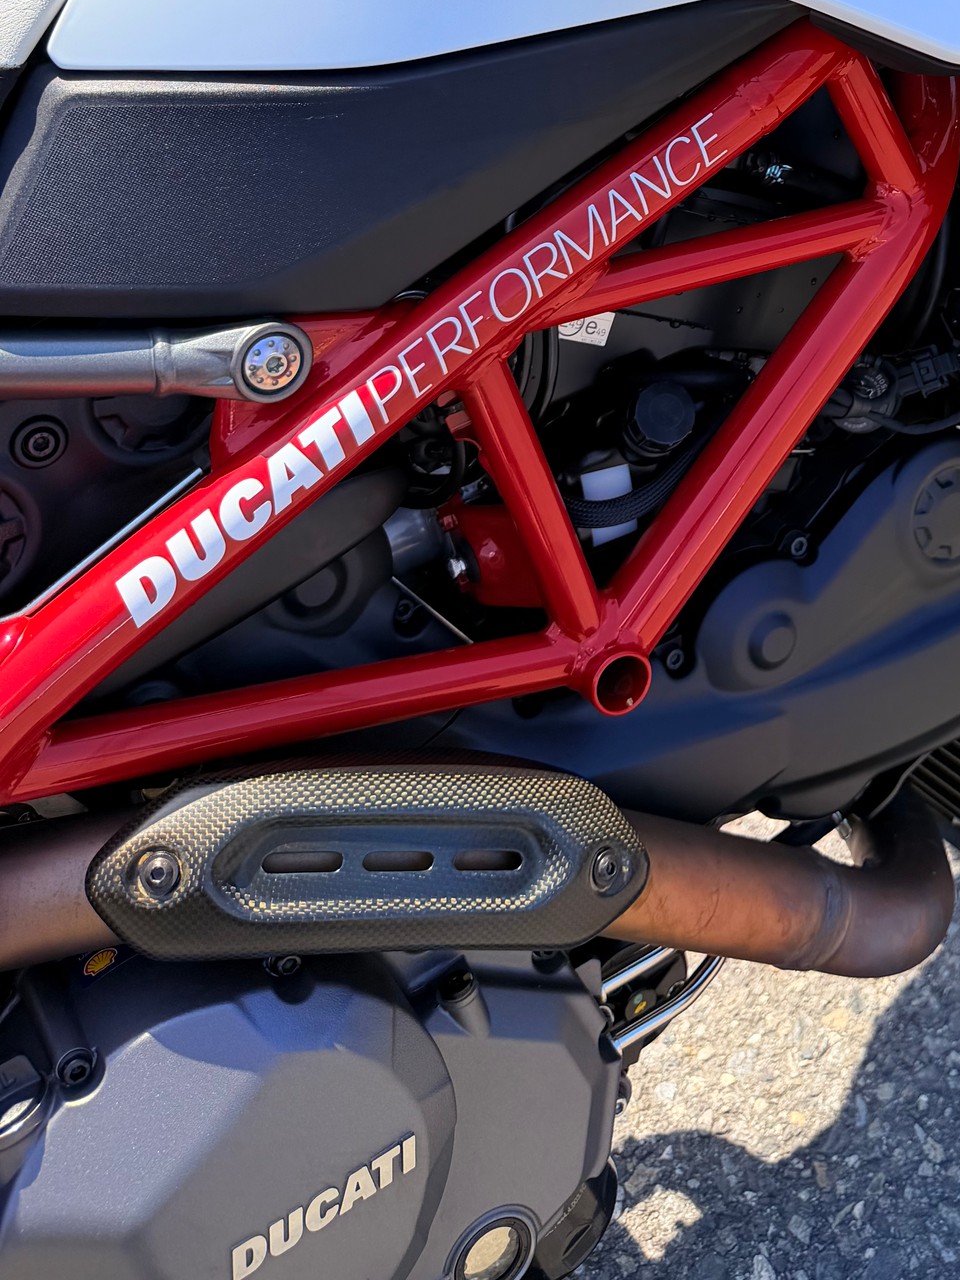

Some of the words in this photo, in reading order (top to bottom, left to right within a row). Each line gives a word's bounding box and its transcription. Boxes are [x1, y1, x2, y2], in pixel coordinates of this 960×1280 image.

[115, 389, 377, 629] DUCATI
[366, 113, 728, 425] PERFORMANCE
[231, 1132, 416, 1280] DUCATI
